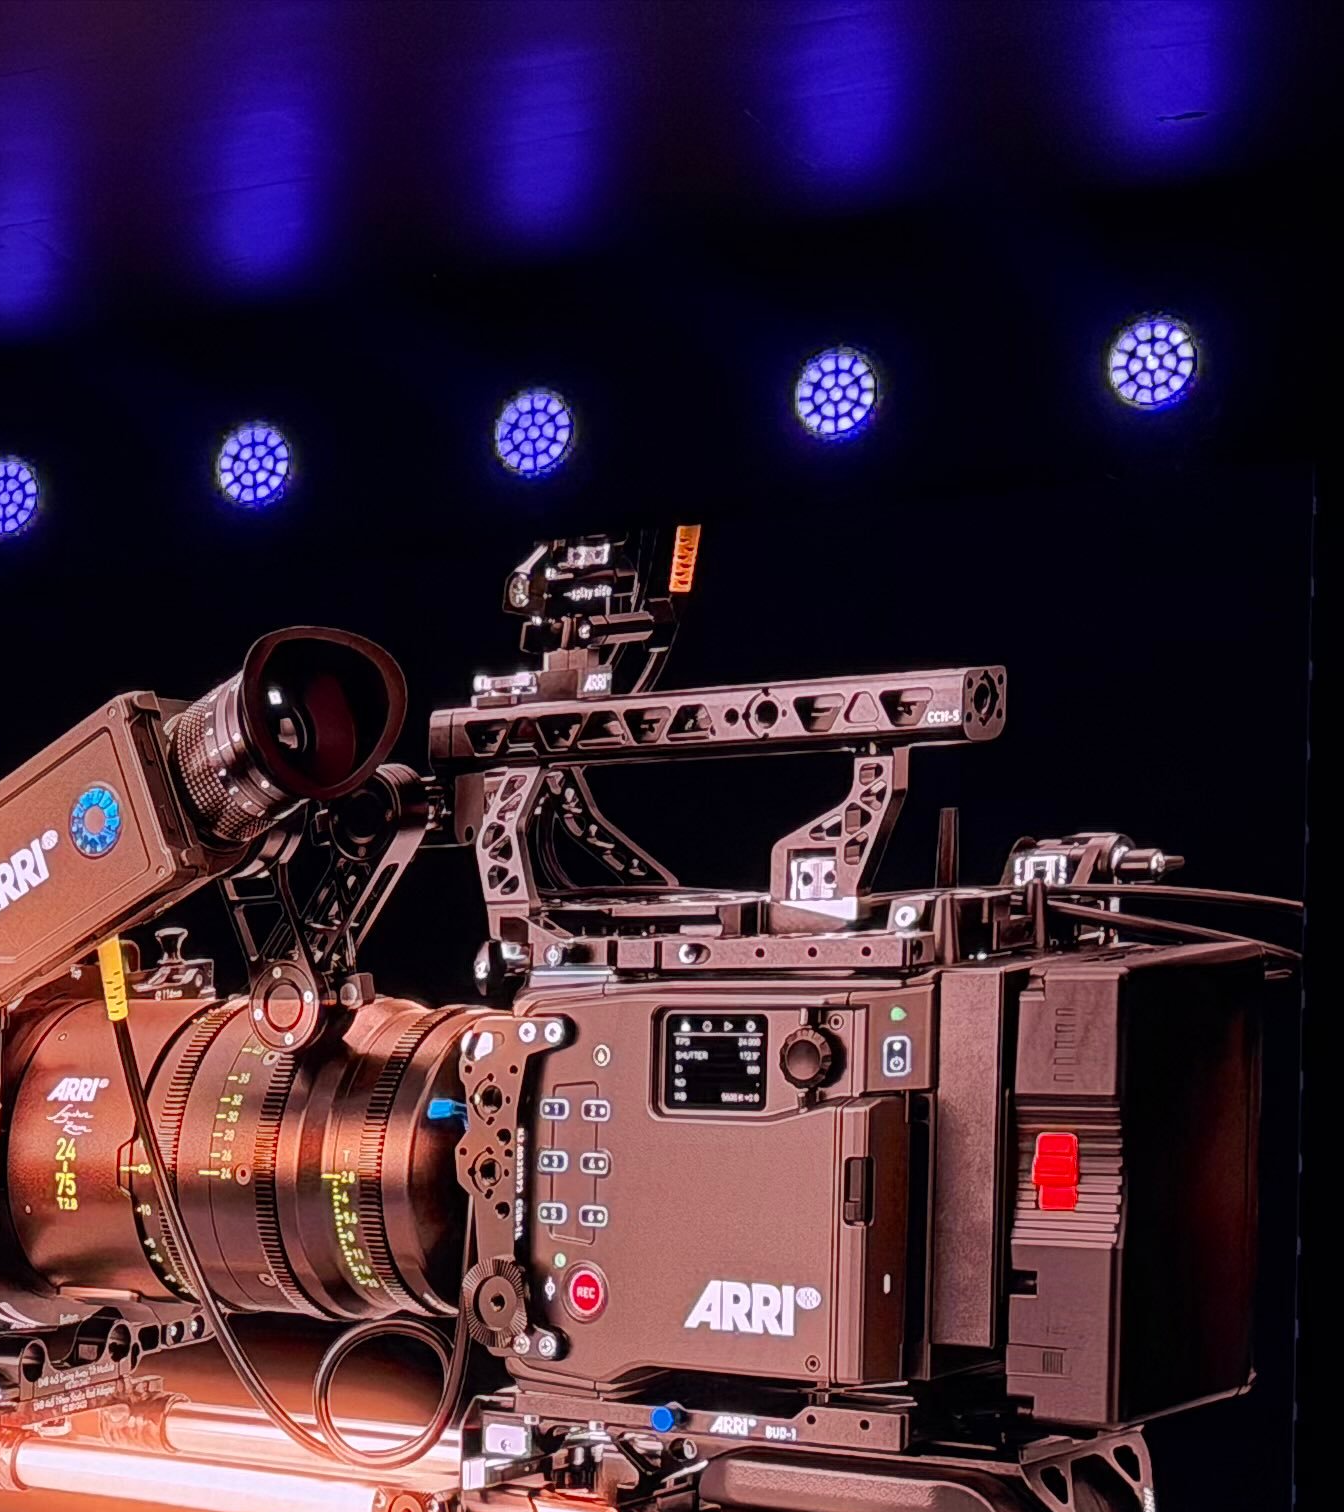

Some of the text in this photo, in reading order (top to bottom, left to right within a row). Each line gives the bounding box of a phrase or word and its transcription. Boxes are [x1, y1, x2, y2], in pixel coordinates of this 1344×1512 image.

[47, 1077, 100, 1102] ARRI
[55, 1138, 77, 1162] 24
[55, 1173, 77, 1196] 75
[576, 1286, 596, 1300] REC
[684, 1280, 796, 1337] ARRI
[710, 1415, 749, 1437] ARRI
